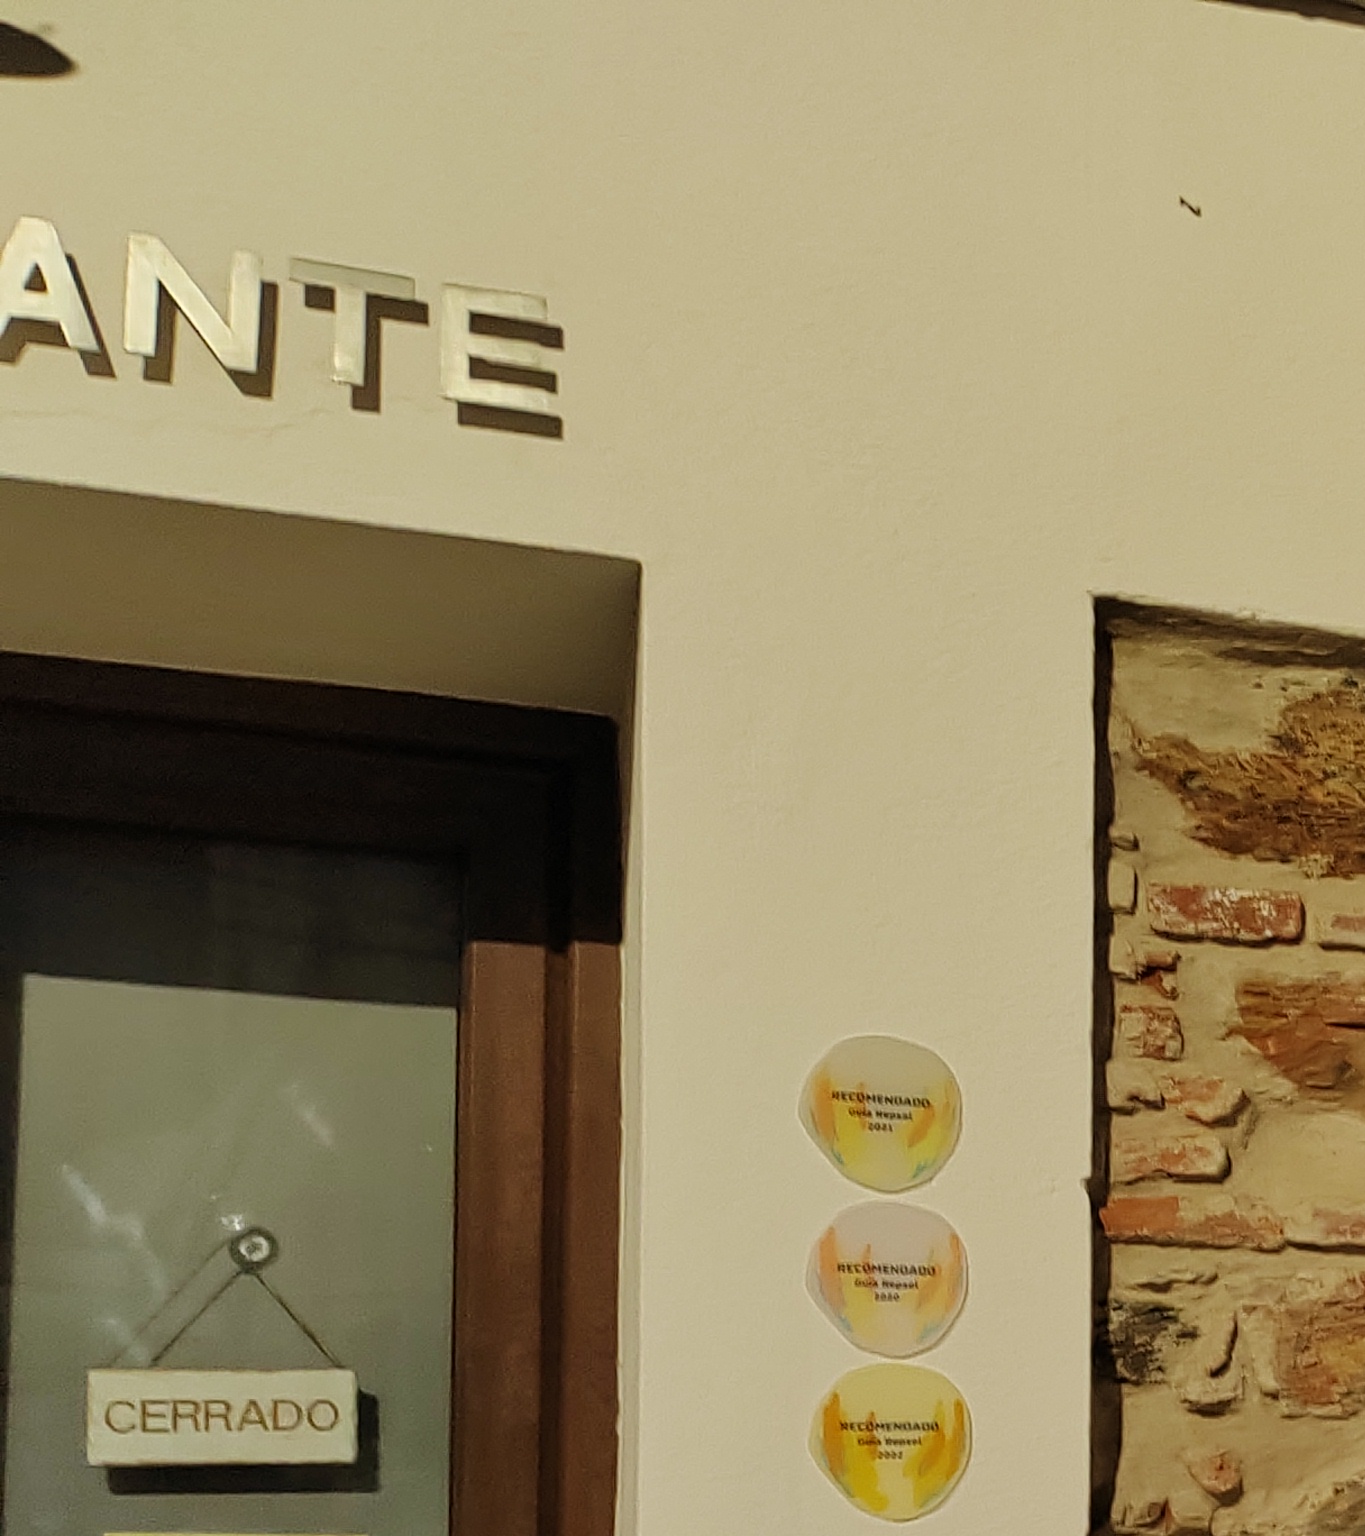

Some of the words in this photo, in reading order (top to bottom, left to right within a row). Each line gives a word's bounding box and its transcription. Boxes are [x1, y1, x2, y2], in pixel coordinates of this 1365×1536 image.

[831, 1090, 931, 1108] RECOMENDADO
[875, 1109, 913, 1121] Repsol
[837, 1262, 936, 1277] RECOMENDADO
[881, 1278, 919, 1290] Repsol
[103, 1399, 340, 1434] CERRADO
[839, 1420, 940, 1432] RECOMENDADO
